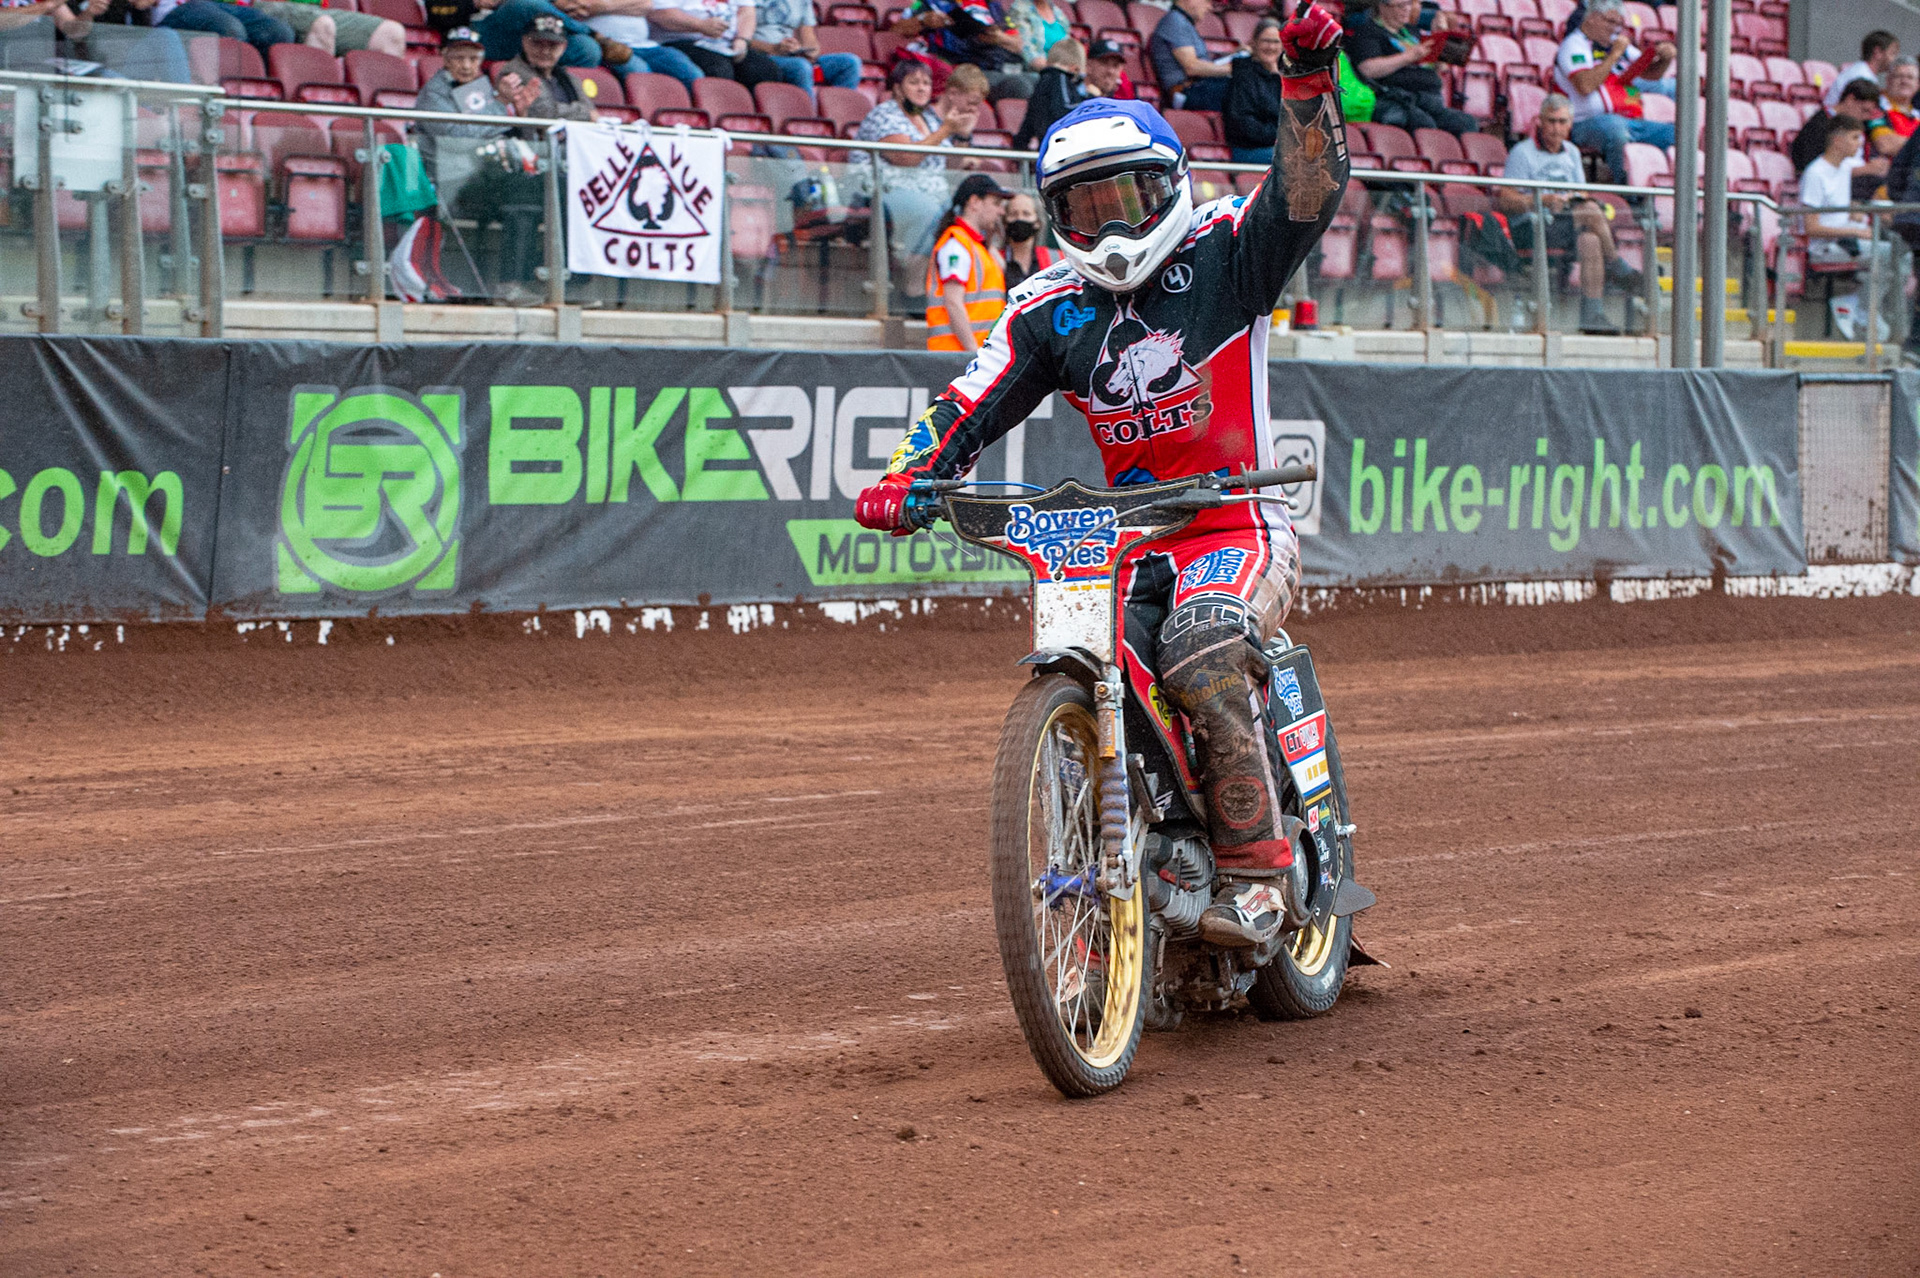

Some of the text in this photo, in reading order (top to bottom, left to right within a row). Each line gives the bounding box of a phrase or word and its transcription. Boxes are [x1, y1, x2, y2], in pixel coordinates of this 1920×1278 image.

[578, 141, 713, 219] BELLE VUE
[603, 238, 695, 271] COLTS
[1095, 391, 1214, 445] COLTS
[488, 386, 1053, 505] BIKERIGT
[1350, 437, 1781, 553] bike-right.com
[1007, 505, 1119, 544] Bowen
[1042, 540, 1108, 572] Pies
[1213, 547, 1246, 584] owen
